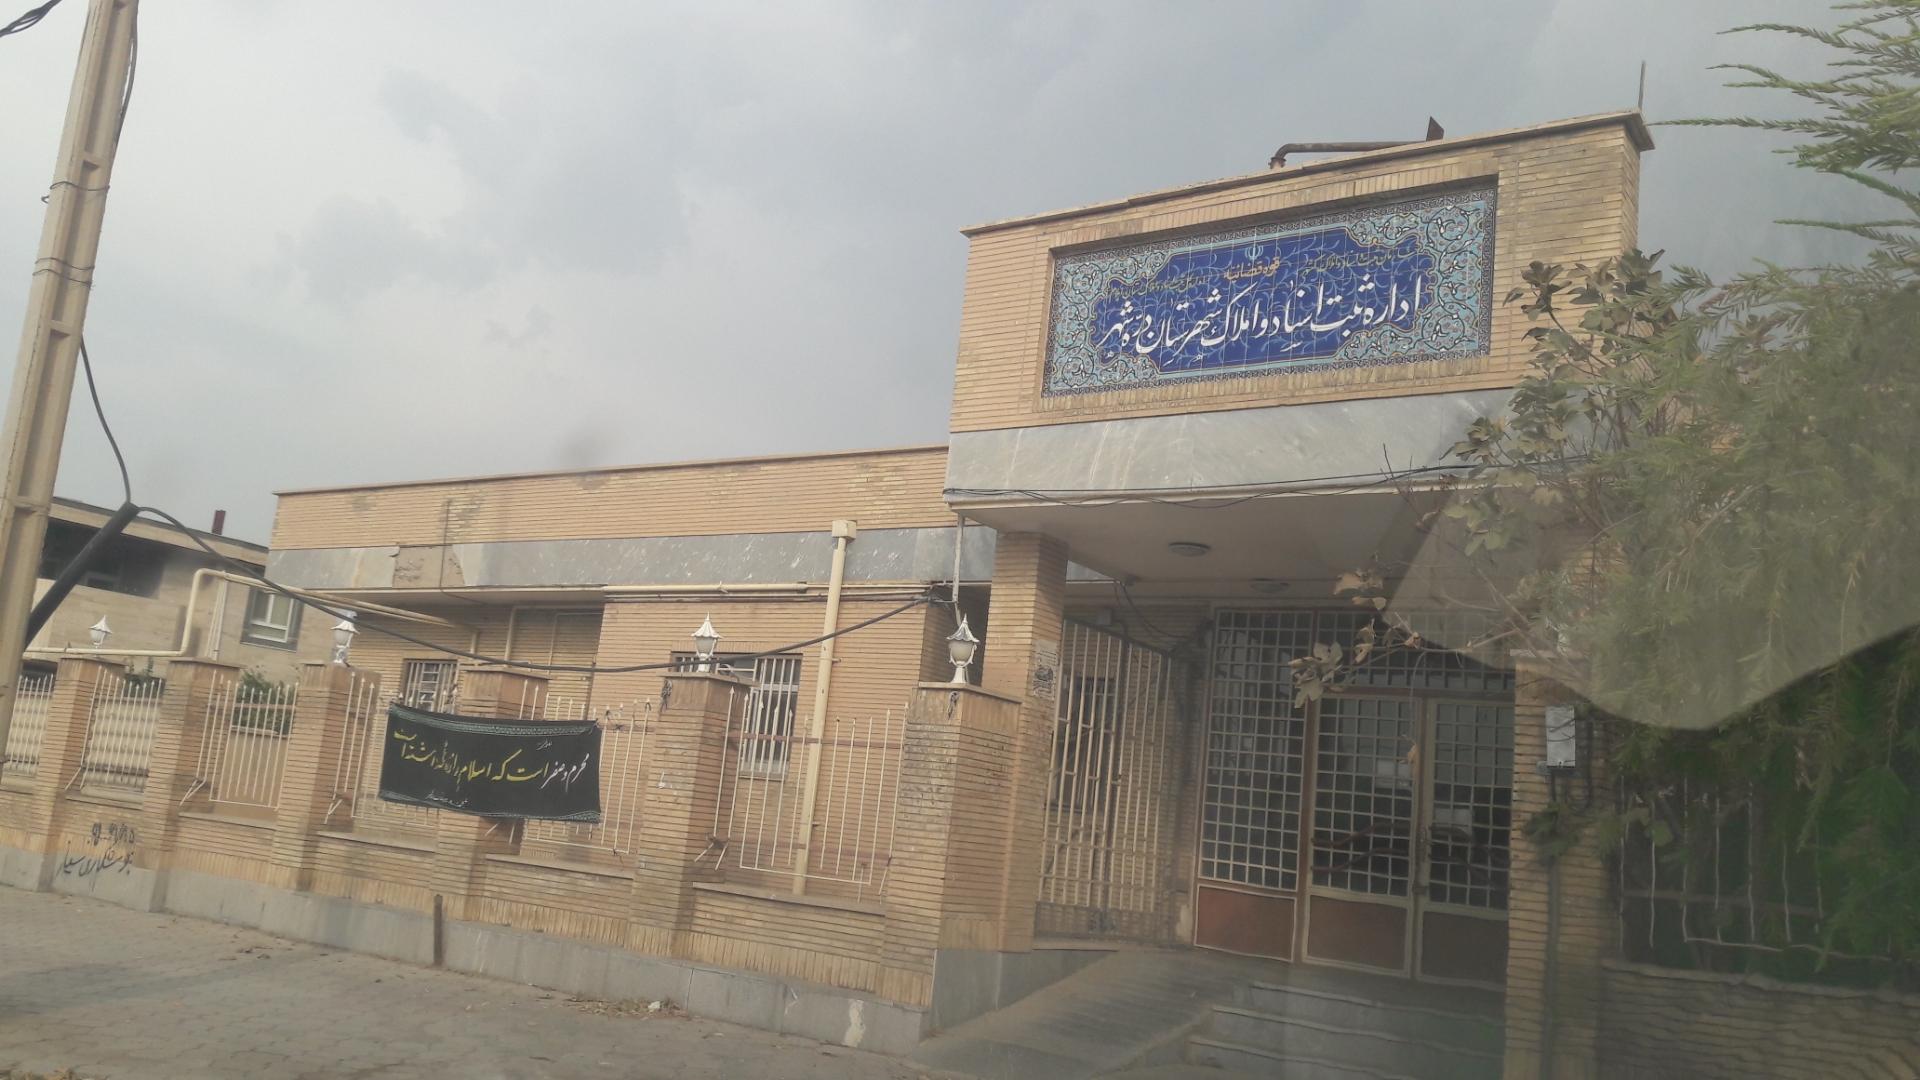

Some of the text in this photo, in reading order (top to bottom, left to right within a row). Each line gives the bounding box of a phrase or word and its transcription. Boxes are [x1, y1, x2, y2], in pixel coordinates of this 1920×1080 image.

[1263, 257, 1281, 277] قوه
[1200, 281, 1260, 347] املاک
[1268, 281, 1324, 338] اسناد
[1310, 273, 1363, 338] ثبت
[1363, 275, 1421, 326] اداره
[1096, 300, 1136, 348] شهر
[1136, 288, 1223, 355] شهرستان
[1254, 317, 1269, 339] و
[456, 759, 492, 792] اسلام
[491, 748, 523, 781] که
[506, 761, 549, 781] است
[541, 760, 565, 789] صفر
[567, 752, 590, 792] محرم
